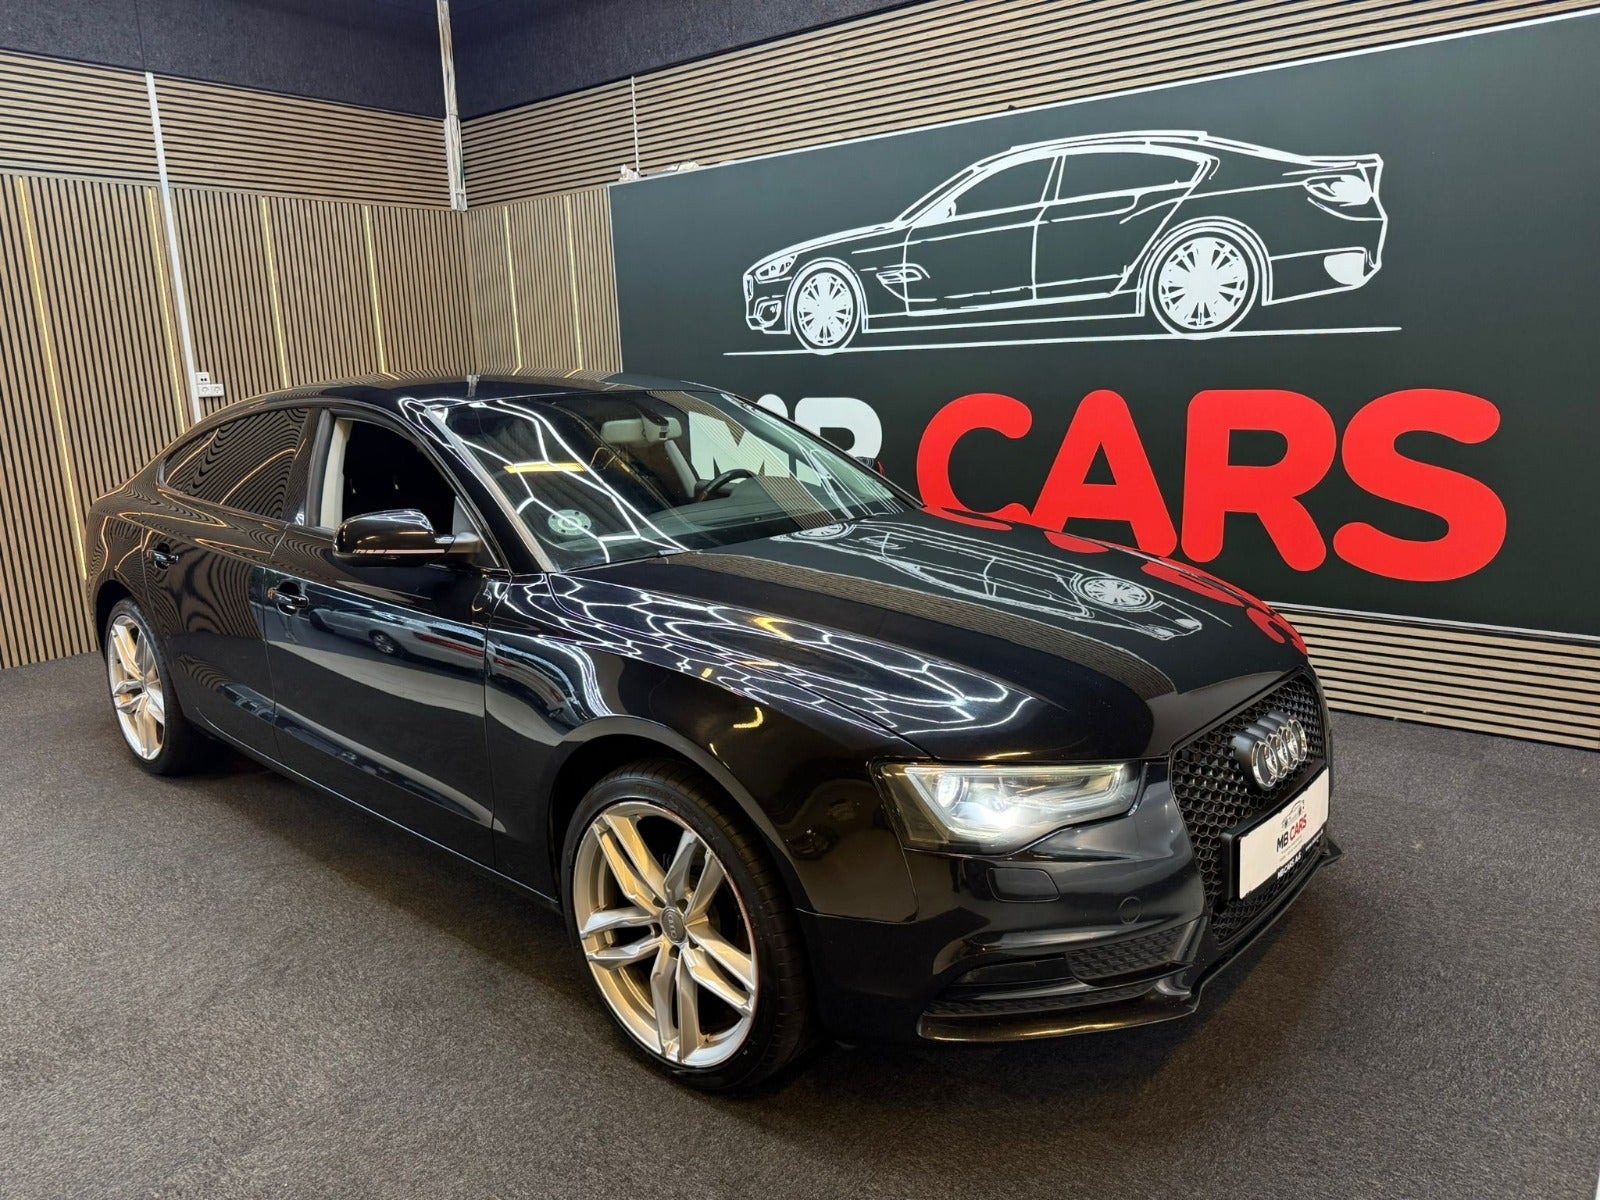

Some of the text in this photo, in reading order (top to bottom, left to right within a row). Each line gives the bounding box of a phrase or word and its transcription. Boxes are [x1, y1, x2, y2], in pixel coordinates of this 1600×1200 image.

[916, 388, 1507, 582] CARS
[1276, 831, 1289, 853] MB
[1289, 814, 1307, 841] CARS
